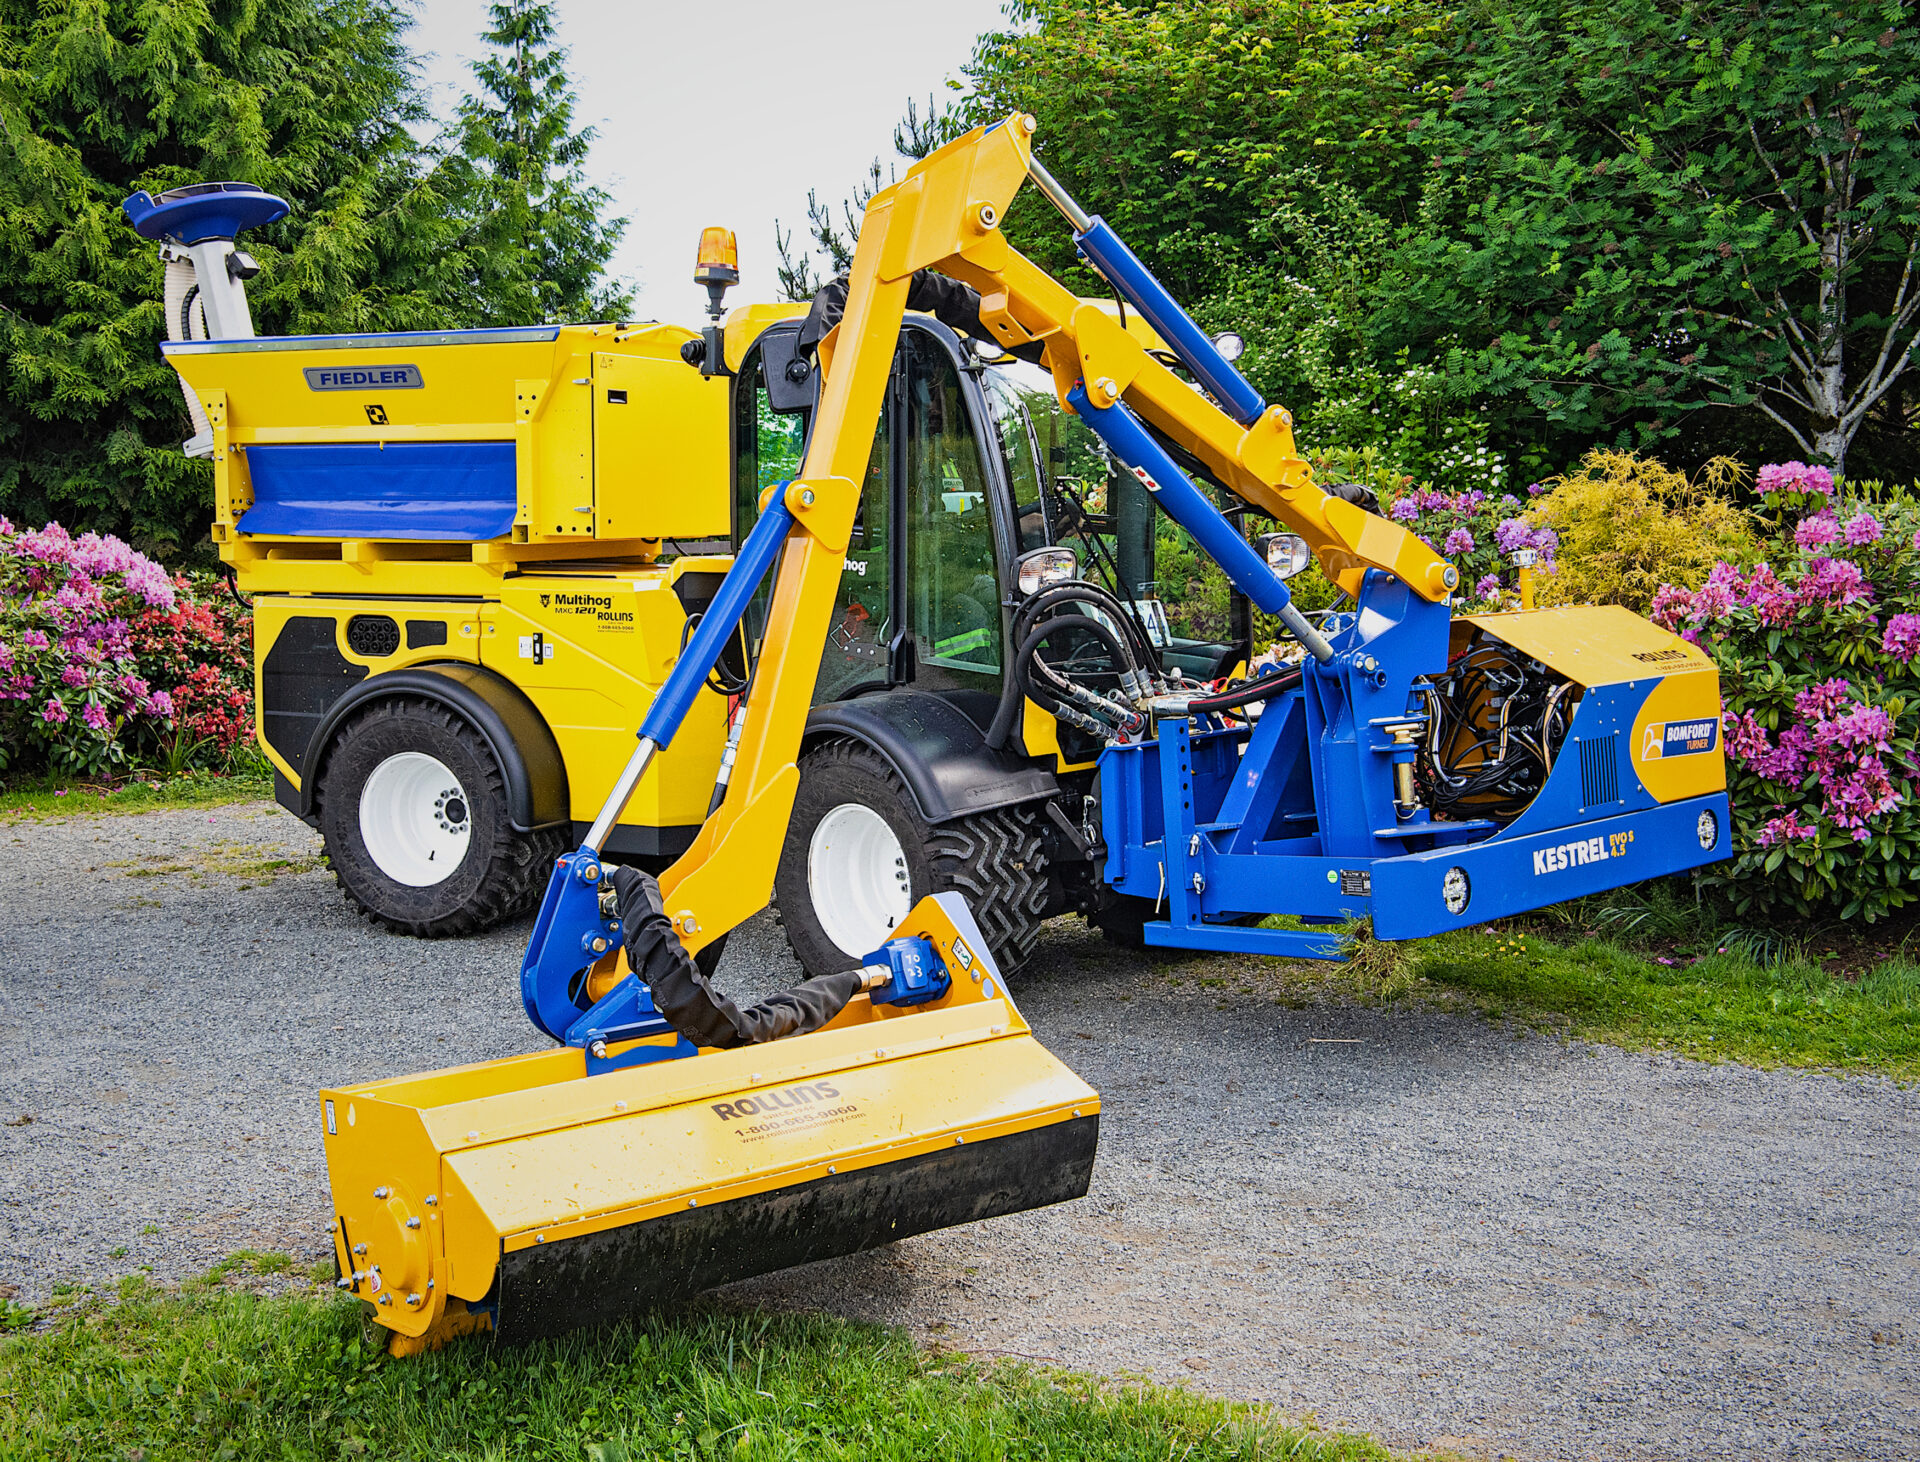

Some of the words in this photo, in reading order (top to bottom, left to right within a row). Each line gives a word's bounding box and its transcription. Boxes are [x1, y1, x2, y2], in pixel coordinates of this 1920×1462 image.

[320, 370, 408, 386] FIEDLER
[555, 594, 612, 609] Multihog
[597, 612, 634, 622] ROLLINS
[1666, 723, 1710, 742] BOMFORD
[1686, 739, 1708, 750] TURNER
[1609, 832, 1627, 847] EVO
[1628, 830, 1634, 842] S
[1533, 836, 1609, 876] KESTREL
[1611, 844, 1626, 857] 4.5
[711, 1081, 841, 1121] ROLLINS
[734, 1105, 858, 1137] 1-800-665-9060
